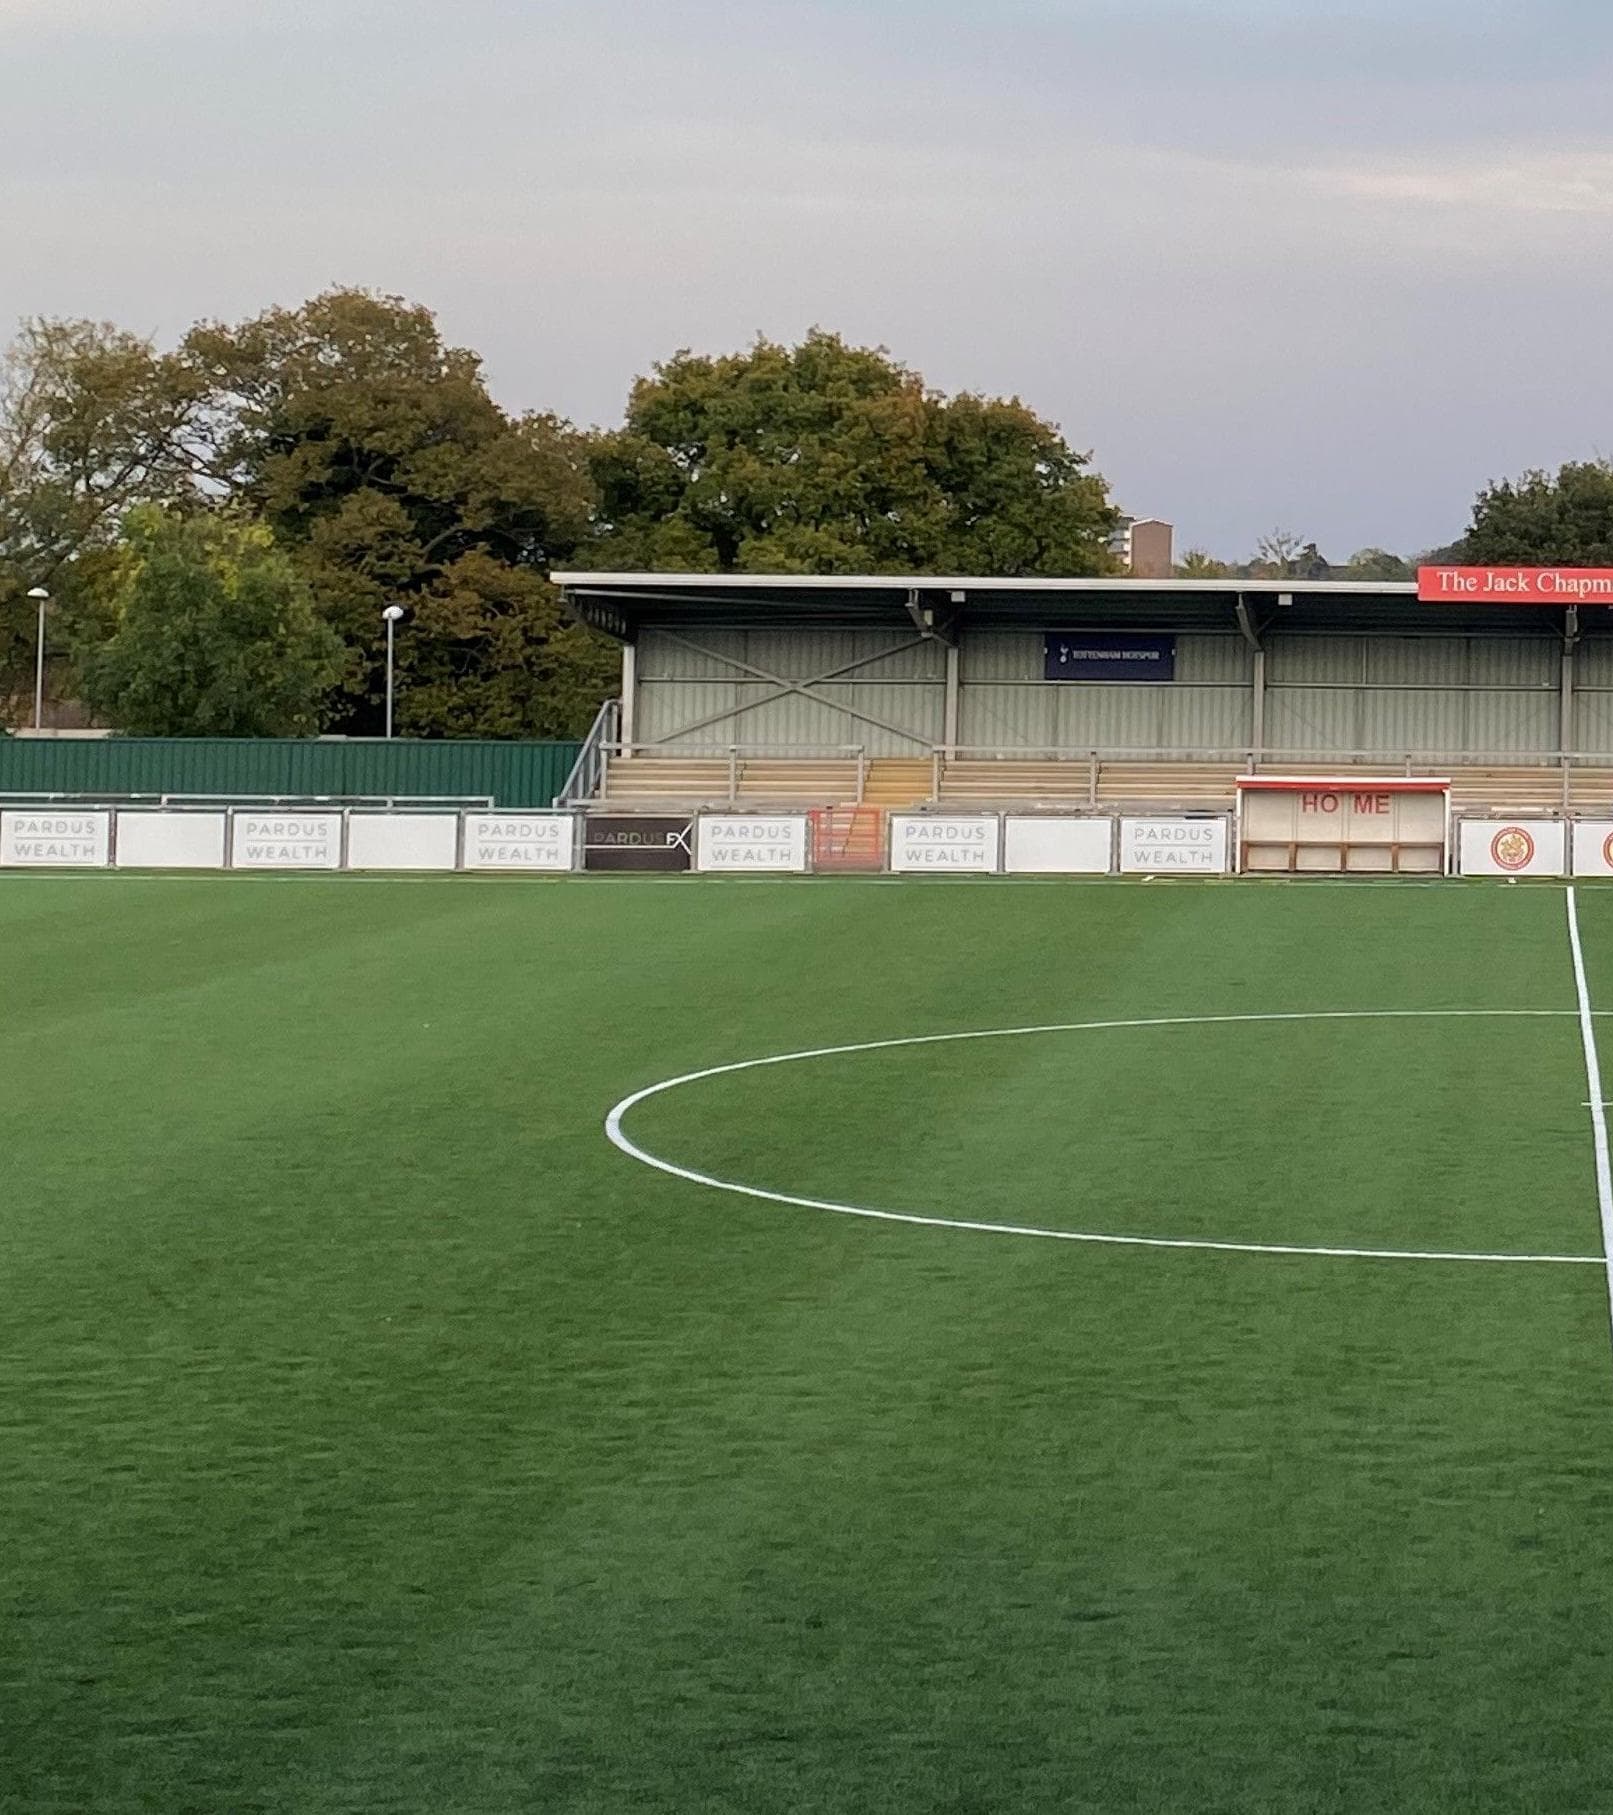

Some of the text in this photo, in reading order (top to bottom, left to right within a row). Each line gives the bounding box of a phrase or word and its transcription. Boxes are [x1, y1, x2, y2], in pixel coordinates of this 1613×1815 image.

[1437, 571, 1477, 592] The
[1483, 572, 1530, 593] Jack
[13, 820, 96, 835] PARDUS
[246, 822, 328, 837] PARDUS
[478, 824, 559, 838] PARDUS
[711, 826, 792, 839] PARDUS
[905, 825, 986, 841] PARDUS
[1134, 828, 1213, 841] PARDUS
[13, 844, 96, 859] WEALTH
[246, 846, 328, 860] WEALTH
[478, 847, 559, 861] WEALTH
[711, 849, 792, 863] WEALTH
[905, 849, 986, 863] WEALTH
[1134, 851, 1213, 865] WEALTH
